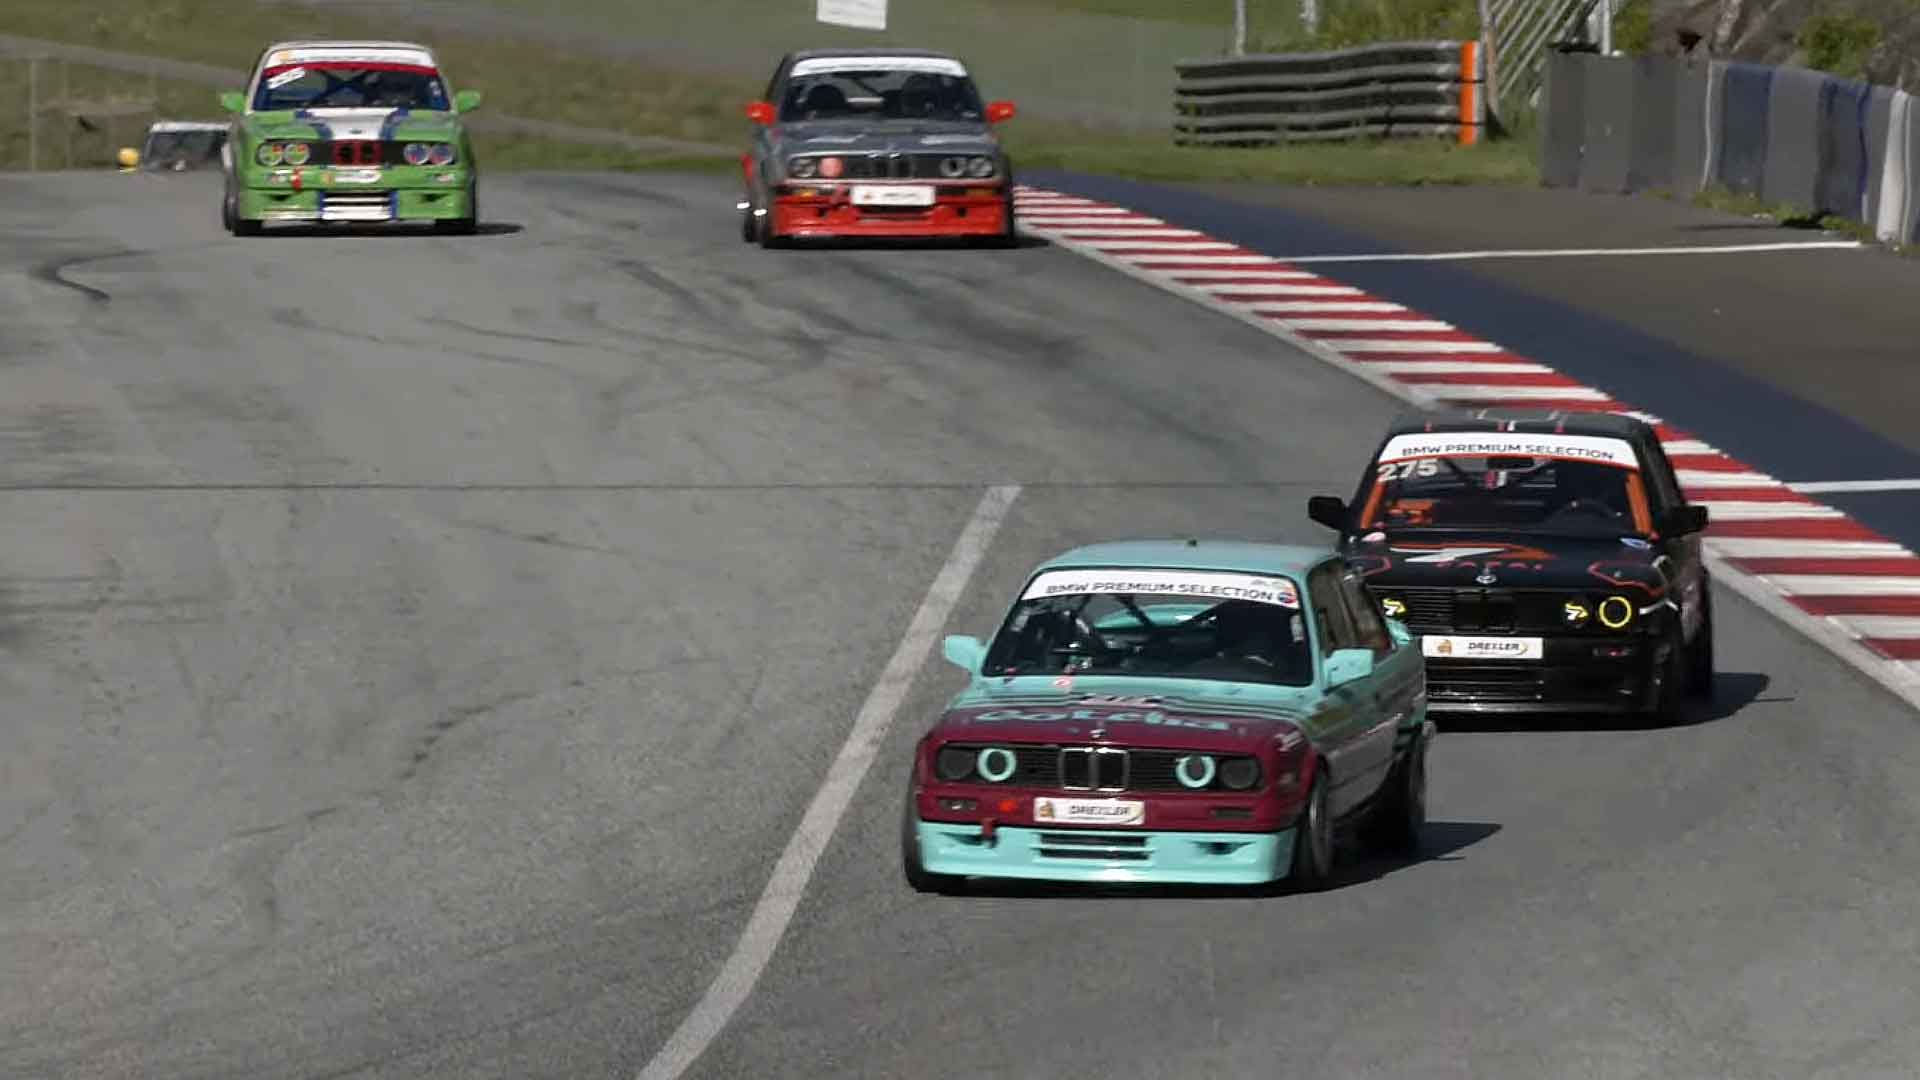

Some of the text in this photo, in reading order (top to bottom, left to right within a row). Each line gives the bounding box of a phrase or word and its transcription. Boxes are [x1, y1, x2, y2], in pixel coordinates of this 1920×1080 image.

[1402, 444, 1614, 460] BMW PREMIUM SELECTION
[1377, 458, 1439, 482] 275
[1046, 582, 1273, 601] BMW PREMIUM SELECTION
[1468, 641, 1520, 650] DREXLER
